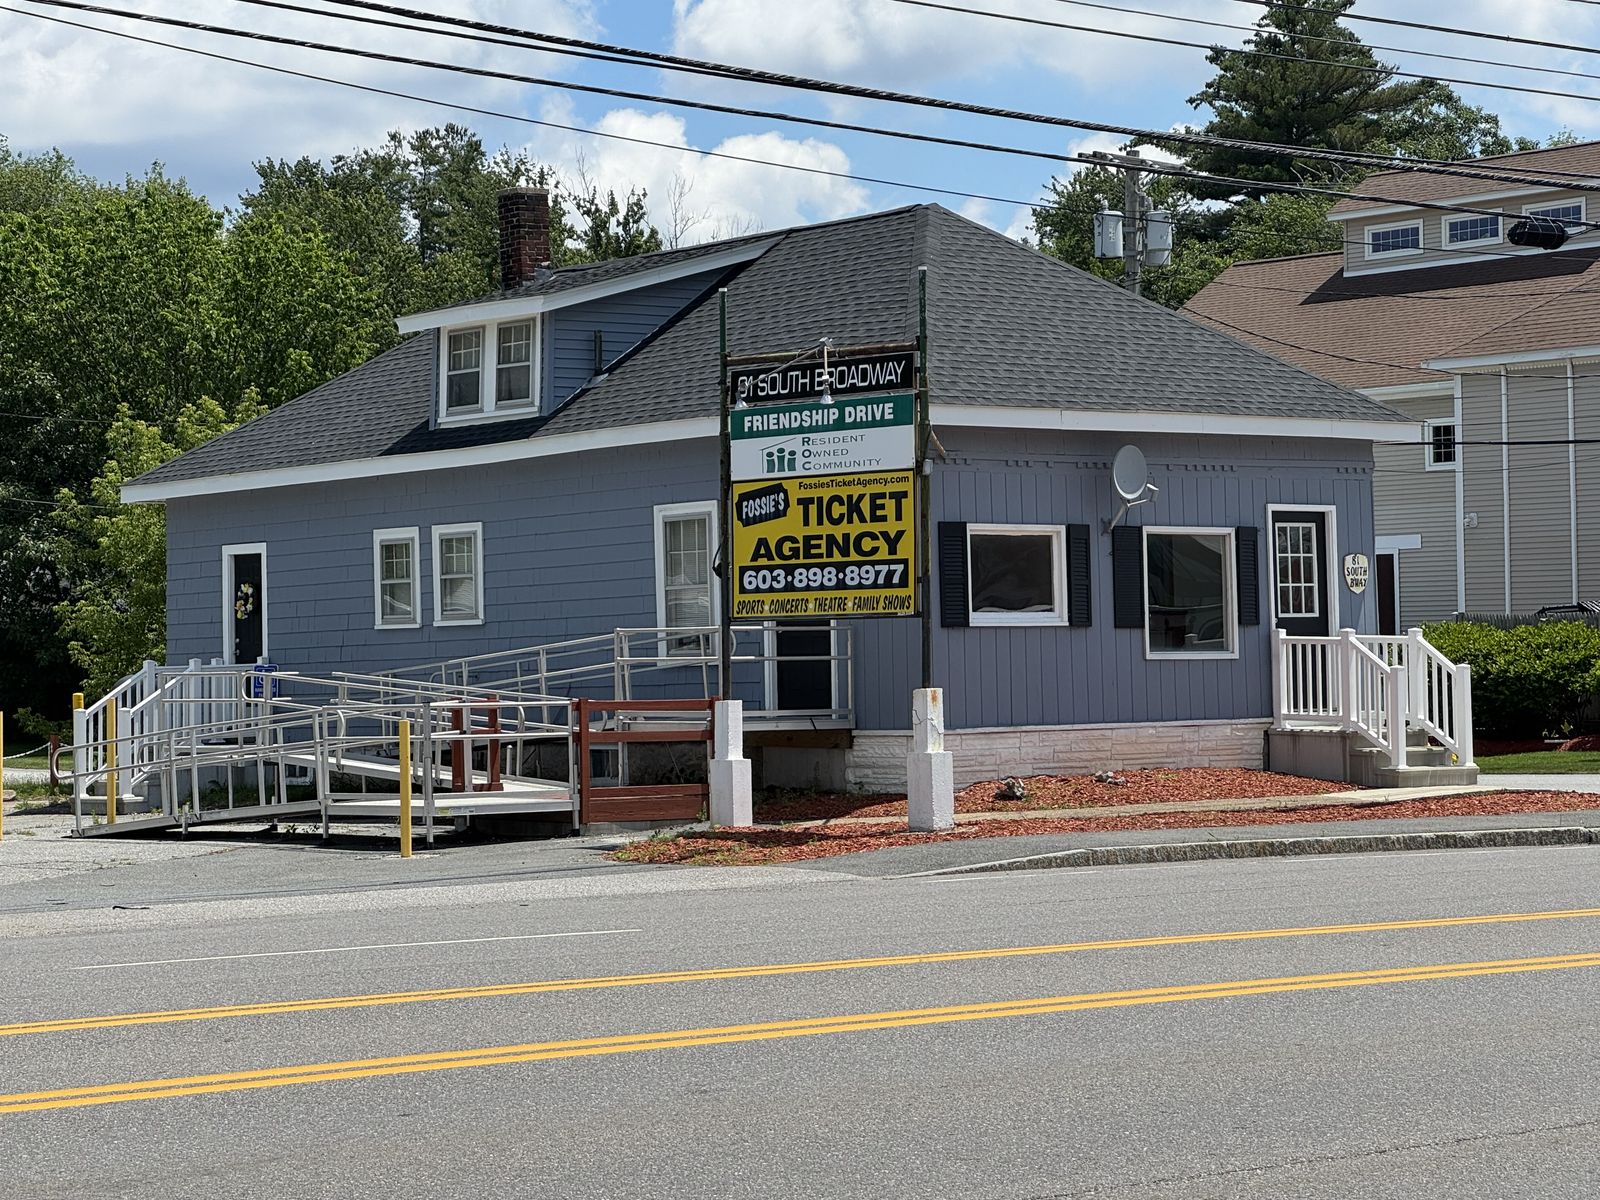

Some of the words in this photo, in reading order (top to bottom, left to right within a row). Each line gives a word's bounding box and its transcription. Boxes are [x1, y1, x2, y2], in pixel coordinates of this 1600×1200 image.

[757, 370, 810, 396] SOUTH
[815, 360, 906, 391] BROADWAY
[744, 408, 839, 432] FRIENDSHIP
[845, 402, 894, 423] DRIVE
[802, 434, 866, 446] RESIDENT
[802, 448, 849, 459] OWNED
[802, 458, 882, 471] COMMUNITY
[798, 475, 910, 491] FossiesTicketAgency.com
[742, 491, 785, 519] FOSSIE'S
[797, 490, 908, 527] TICKET
[750, 529, 907, 562] AGENCY
[1346, 566, 1367, 576] SOUTH
[736, 600, 765, 615] SPORTS
[768, 598, 809, 613] CONCERTS
[813, 596, 848, 612] THEATRE
[852, 595, 881, 611] FAMILY
[882, 594, 912, 610] SHOWS
